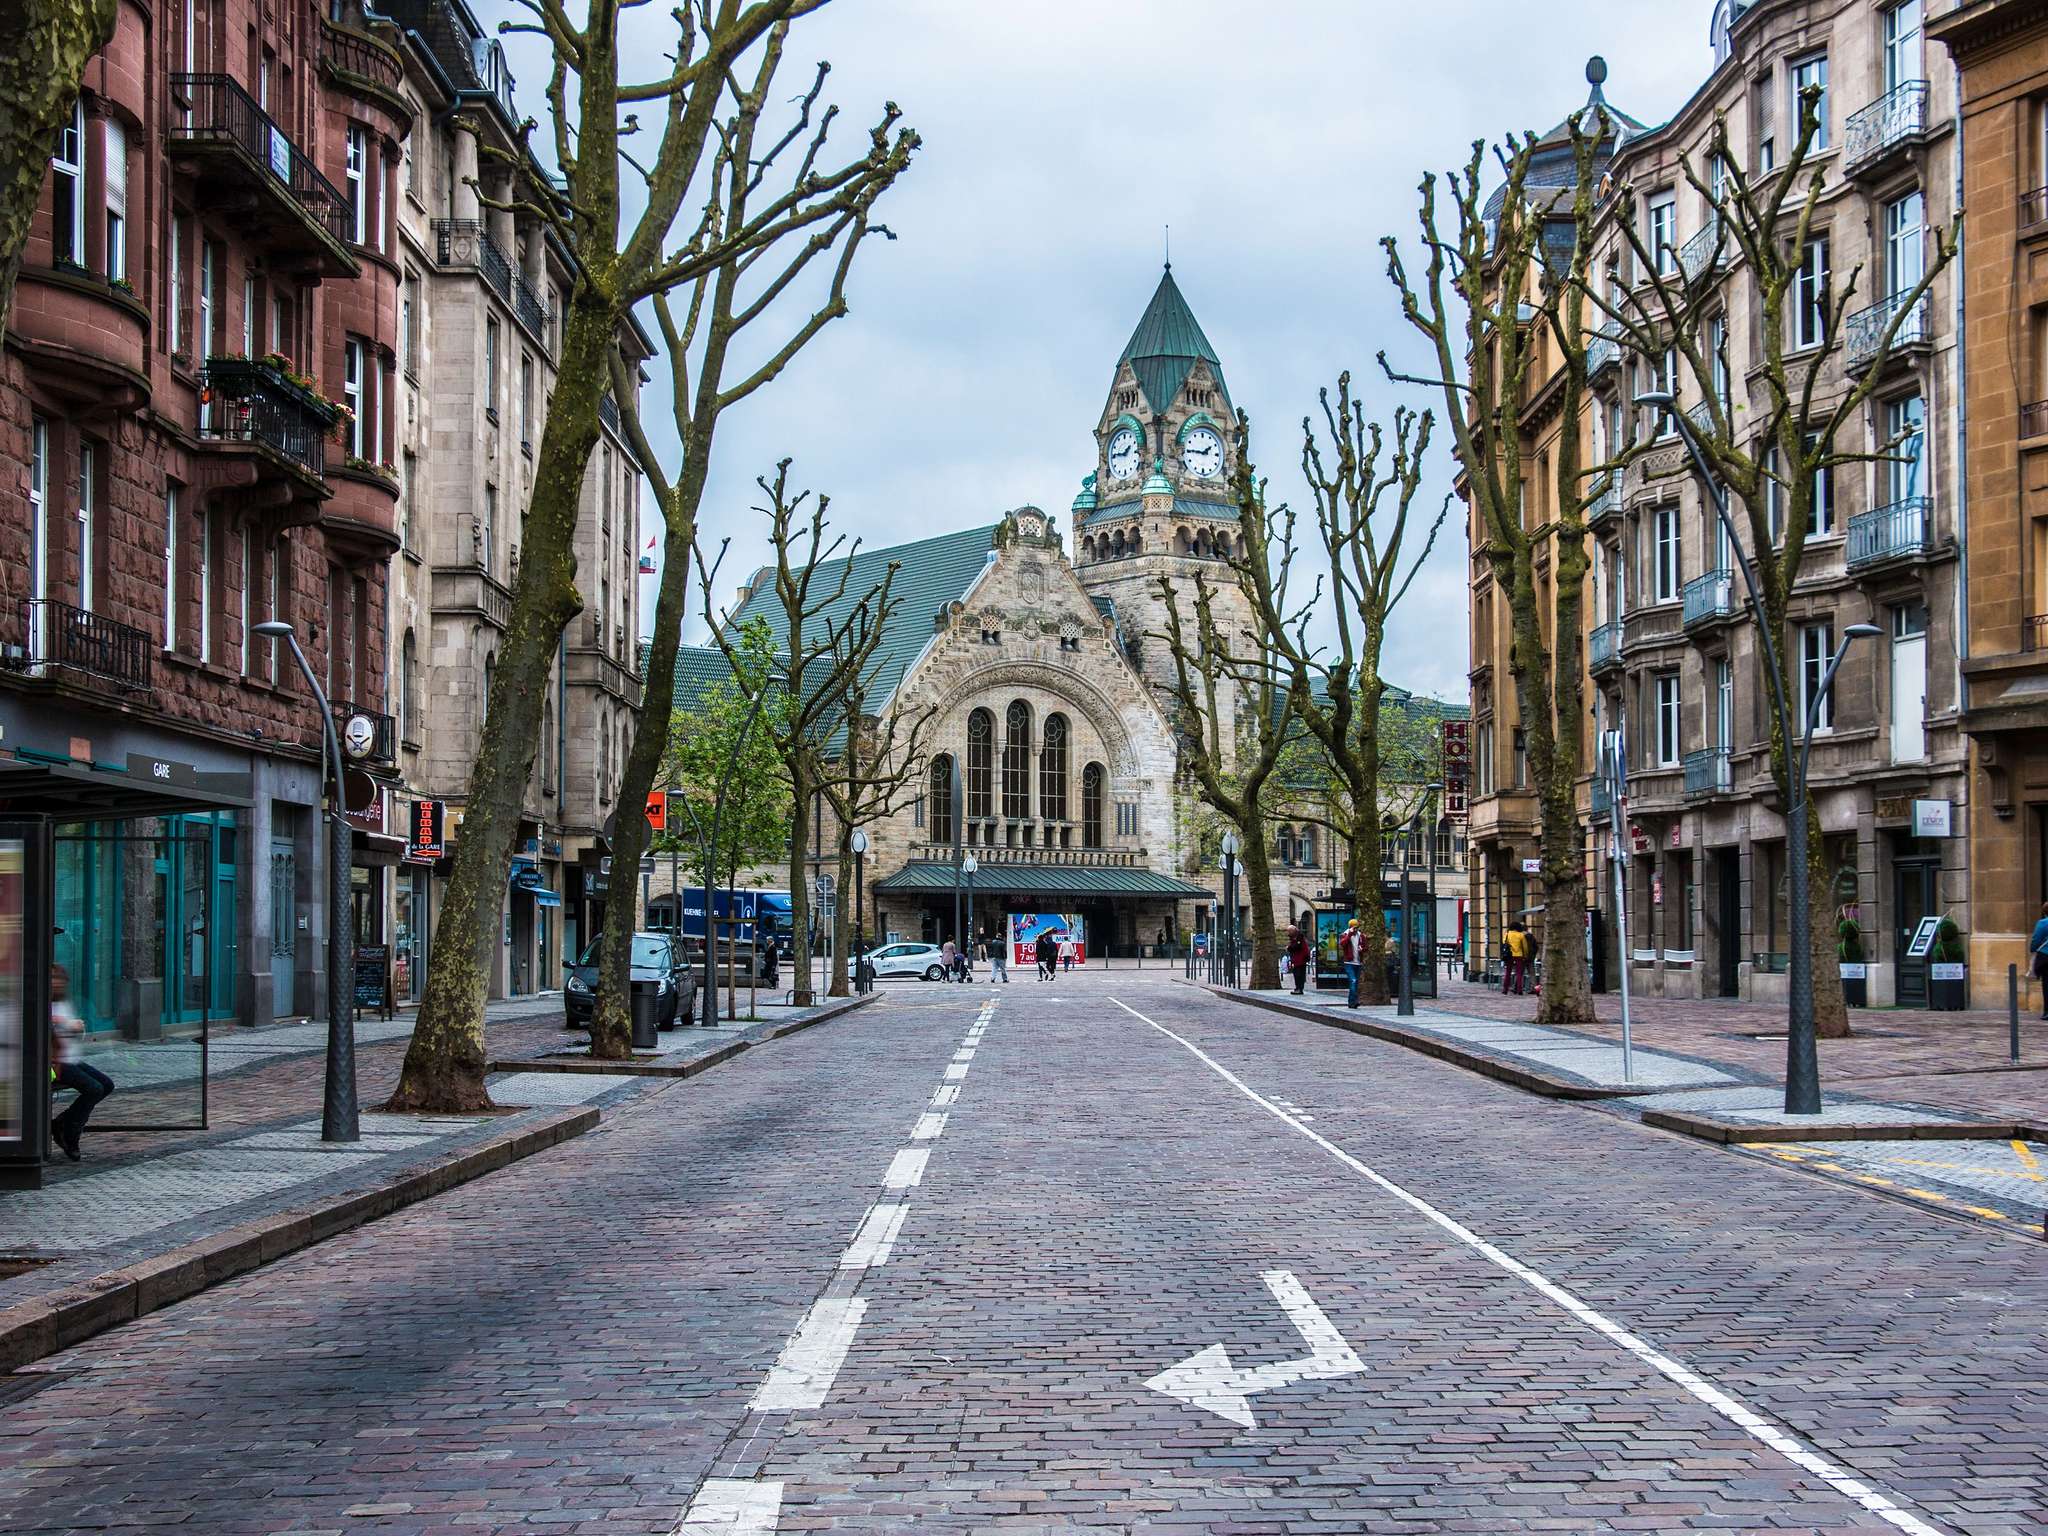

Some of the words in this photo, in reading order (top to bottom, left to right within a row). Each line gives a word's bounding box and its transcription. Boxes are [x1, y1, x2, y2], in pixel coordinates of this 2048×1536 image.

[154, 763, 170, 778] GARE
[1446, 723, 1467, 811] HOTEL
[420, 801, 432, 844] KEBAB
